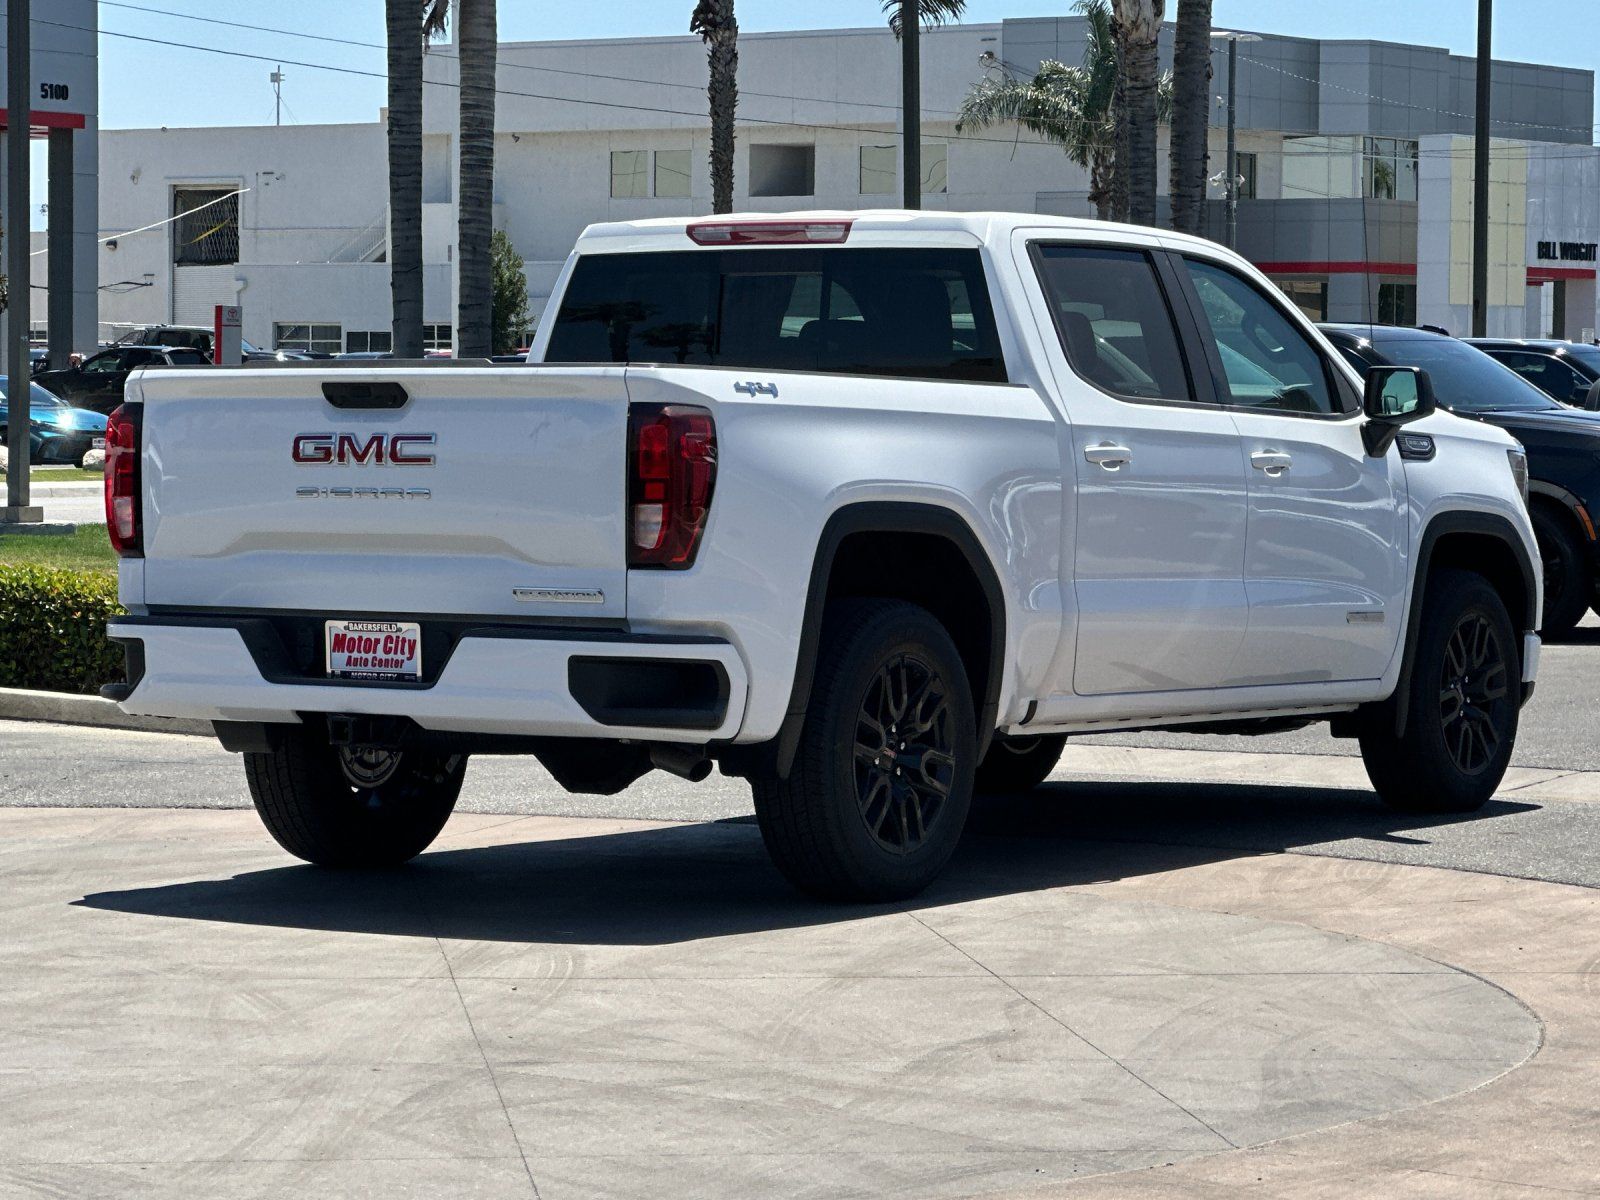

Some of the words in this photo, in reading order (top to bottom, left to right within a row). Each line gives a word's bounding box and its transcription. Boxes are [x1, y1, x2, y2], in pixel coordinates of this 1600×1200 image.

[40, 83, 69, 101] 5100
[1537, 241, 1558, 260] BILL
[292, 432, 437, 466] GMC
[348, 623, 397, 632] BAKERSFIELD
[332, 633, 381, 655] Motor
[382, 634, 417, 661] City
[345, 655, 370, 668] Auto
[371, 656, 405, 669] Center
